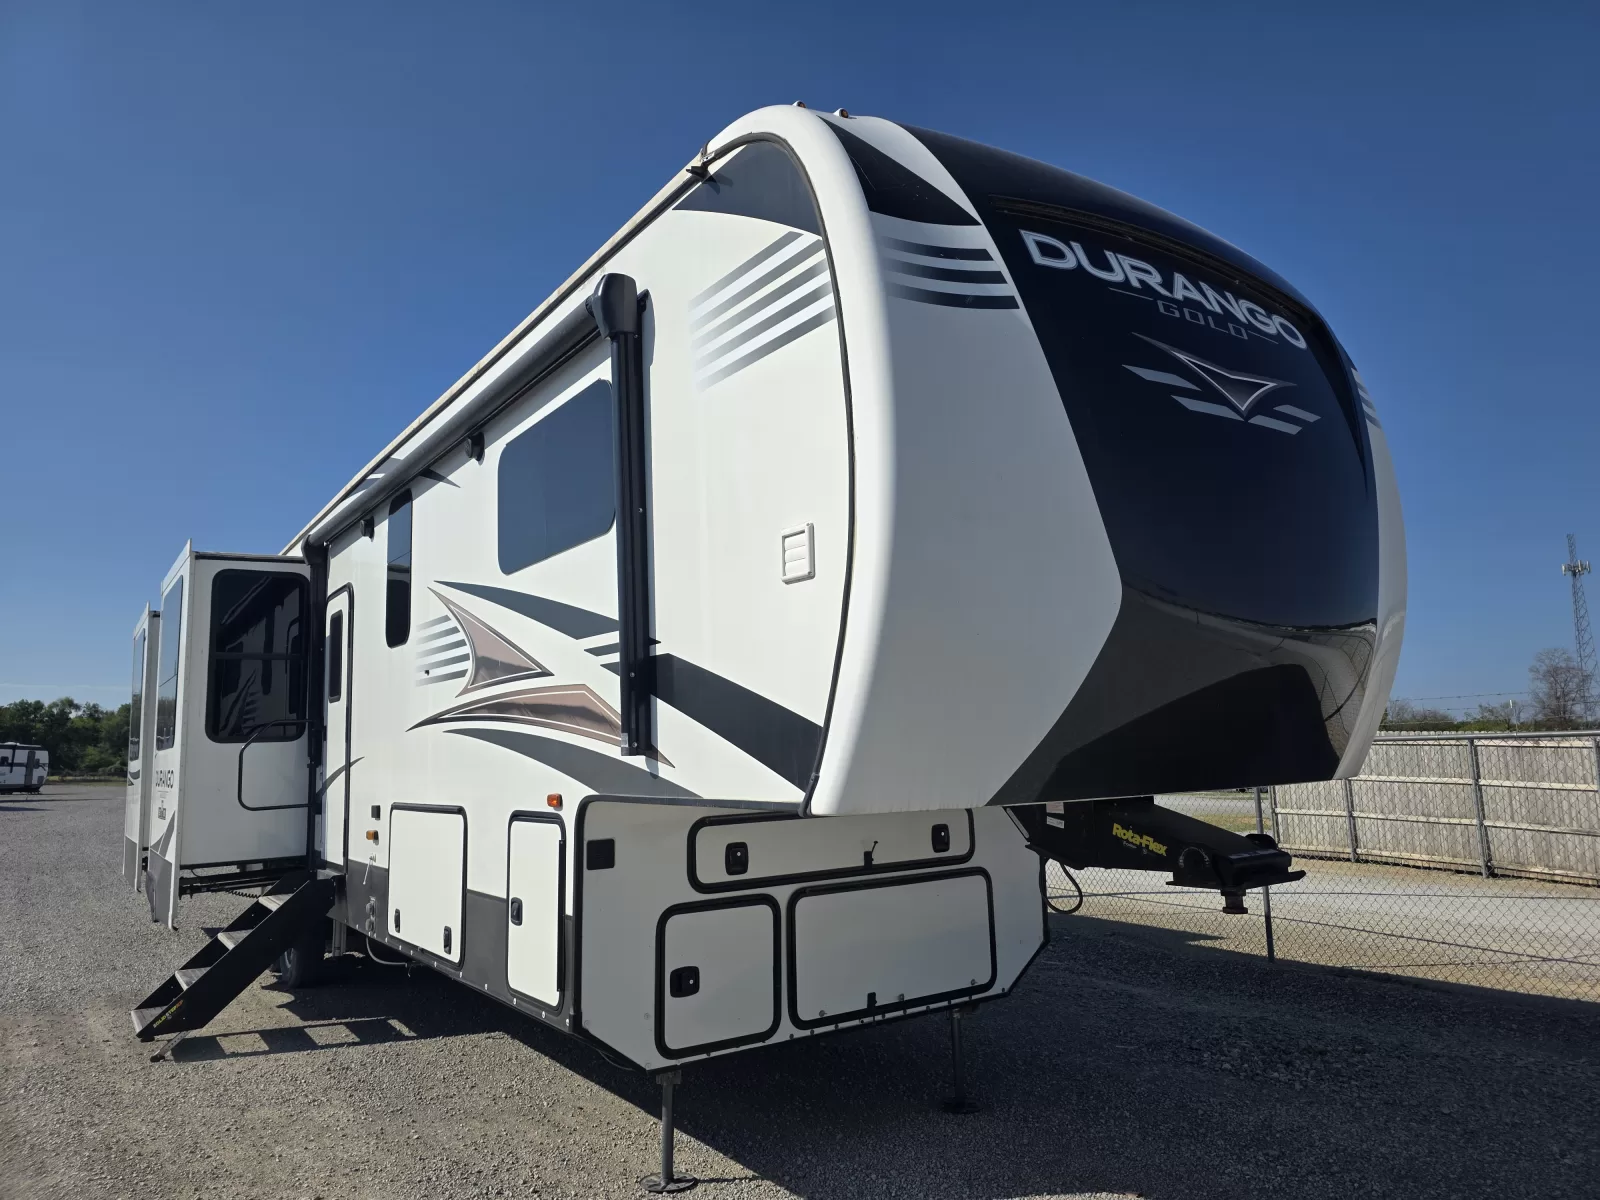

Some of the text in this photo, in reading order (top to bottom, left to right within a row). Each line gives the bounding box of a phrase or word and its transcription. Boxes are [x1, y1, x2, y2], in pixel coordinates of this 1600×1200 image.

[1018, 228, 1308, 350] DURANGO
[1157, 299, 1249, 340] GOLD
[1112, 822, 1168, 857] Rota-Flex
